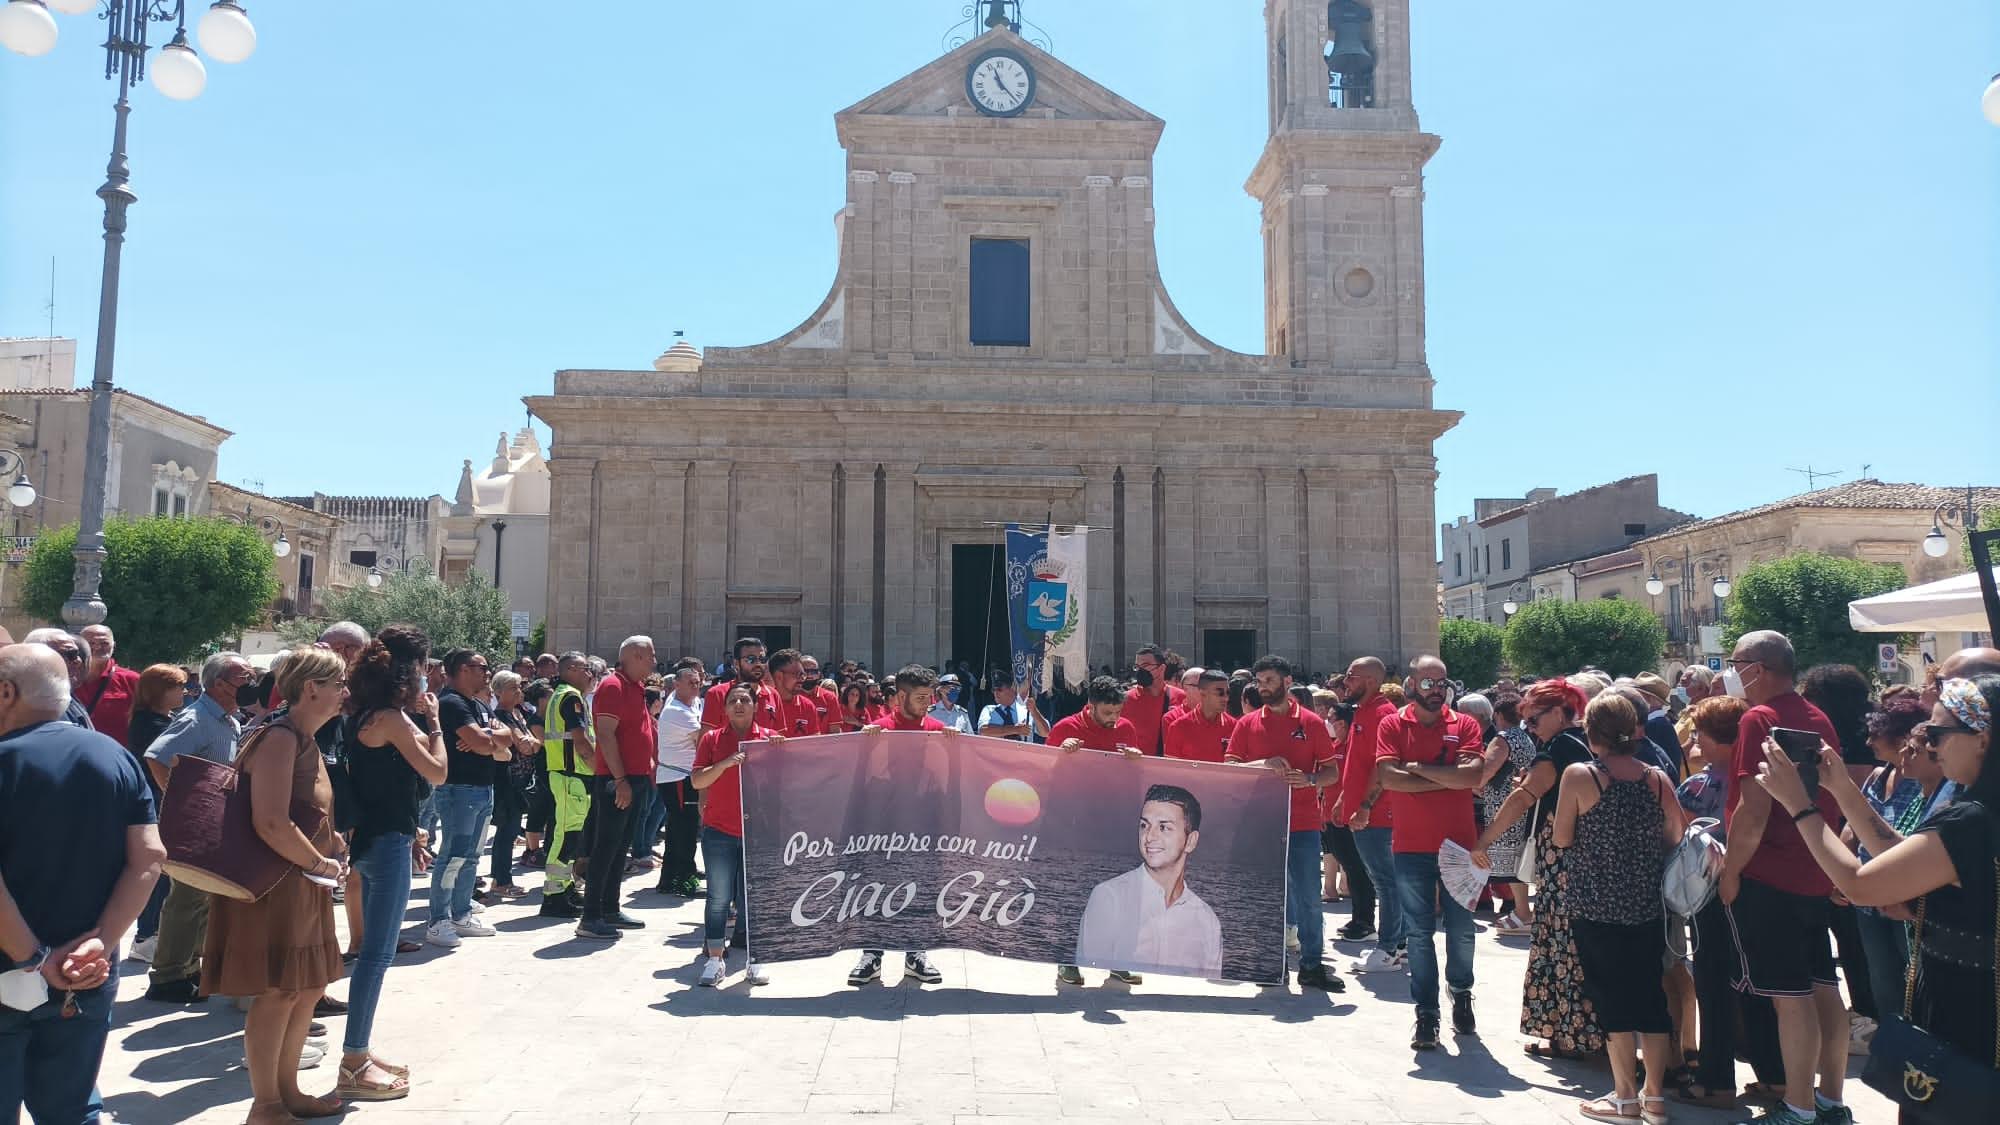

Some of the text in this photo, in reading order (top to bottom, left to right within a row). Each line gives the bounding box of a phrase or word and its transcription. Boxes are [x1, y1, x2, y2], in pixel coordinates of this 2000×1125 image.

[1710, 659, 1718, 669] P
[783, 831, 1037, 866] Per sempre con noi!
[790, 870, 1037, 929] Ciao Giò
